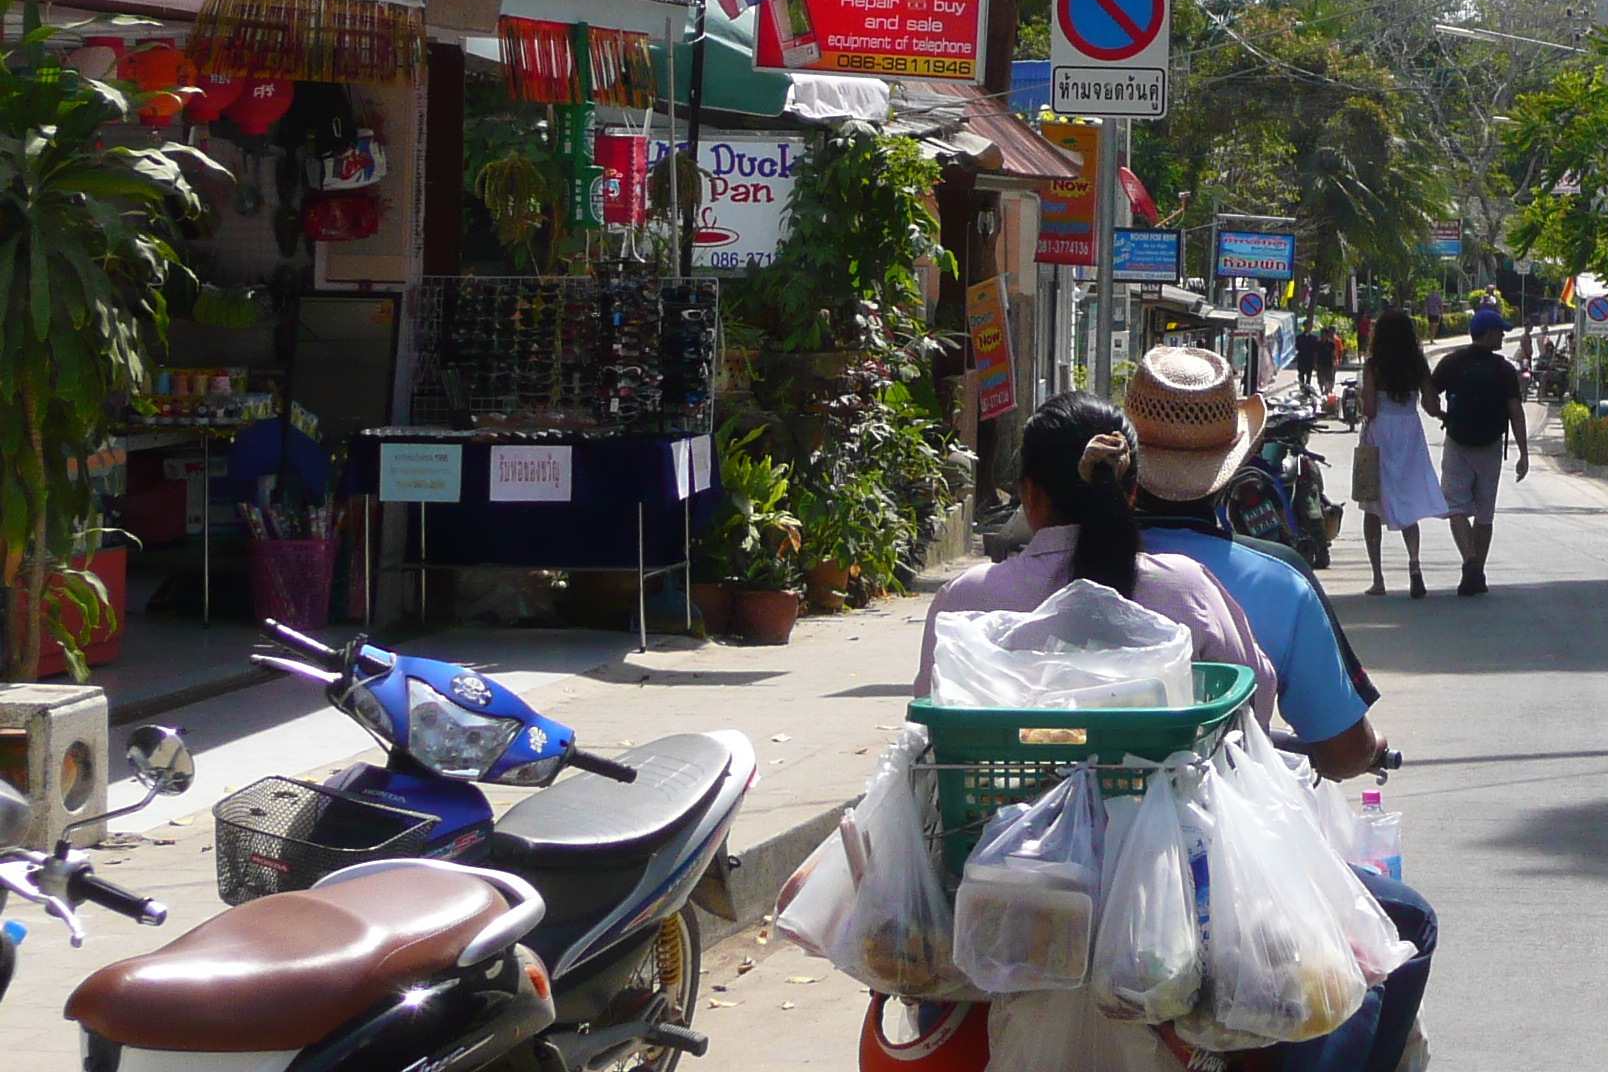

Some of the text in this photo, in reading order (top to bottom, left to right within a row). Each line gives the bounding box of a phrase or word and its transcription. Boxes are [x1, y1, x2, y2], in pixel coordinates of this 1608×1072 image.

[864, 15, 944, 33] and sale
[827, 32, 972, 56] equipment of telephone
[837, 54, 972, 75] 086-3811946
[1059, 72, 1159, 111] ห้ามจอดวันคู่
[710, 143, 797, 179] Duck
[709, 176, 775, 203] Pan
[1223, 255, 1287, 271] ห้องพัก
[361, 788, 407, 804] HONDA
[252, 855, 289, 873] HONDA
